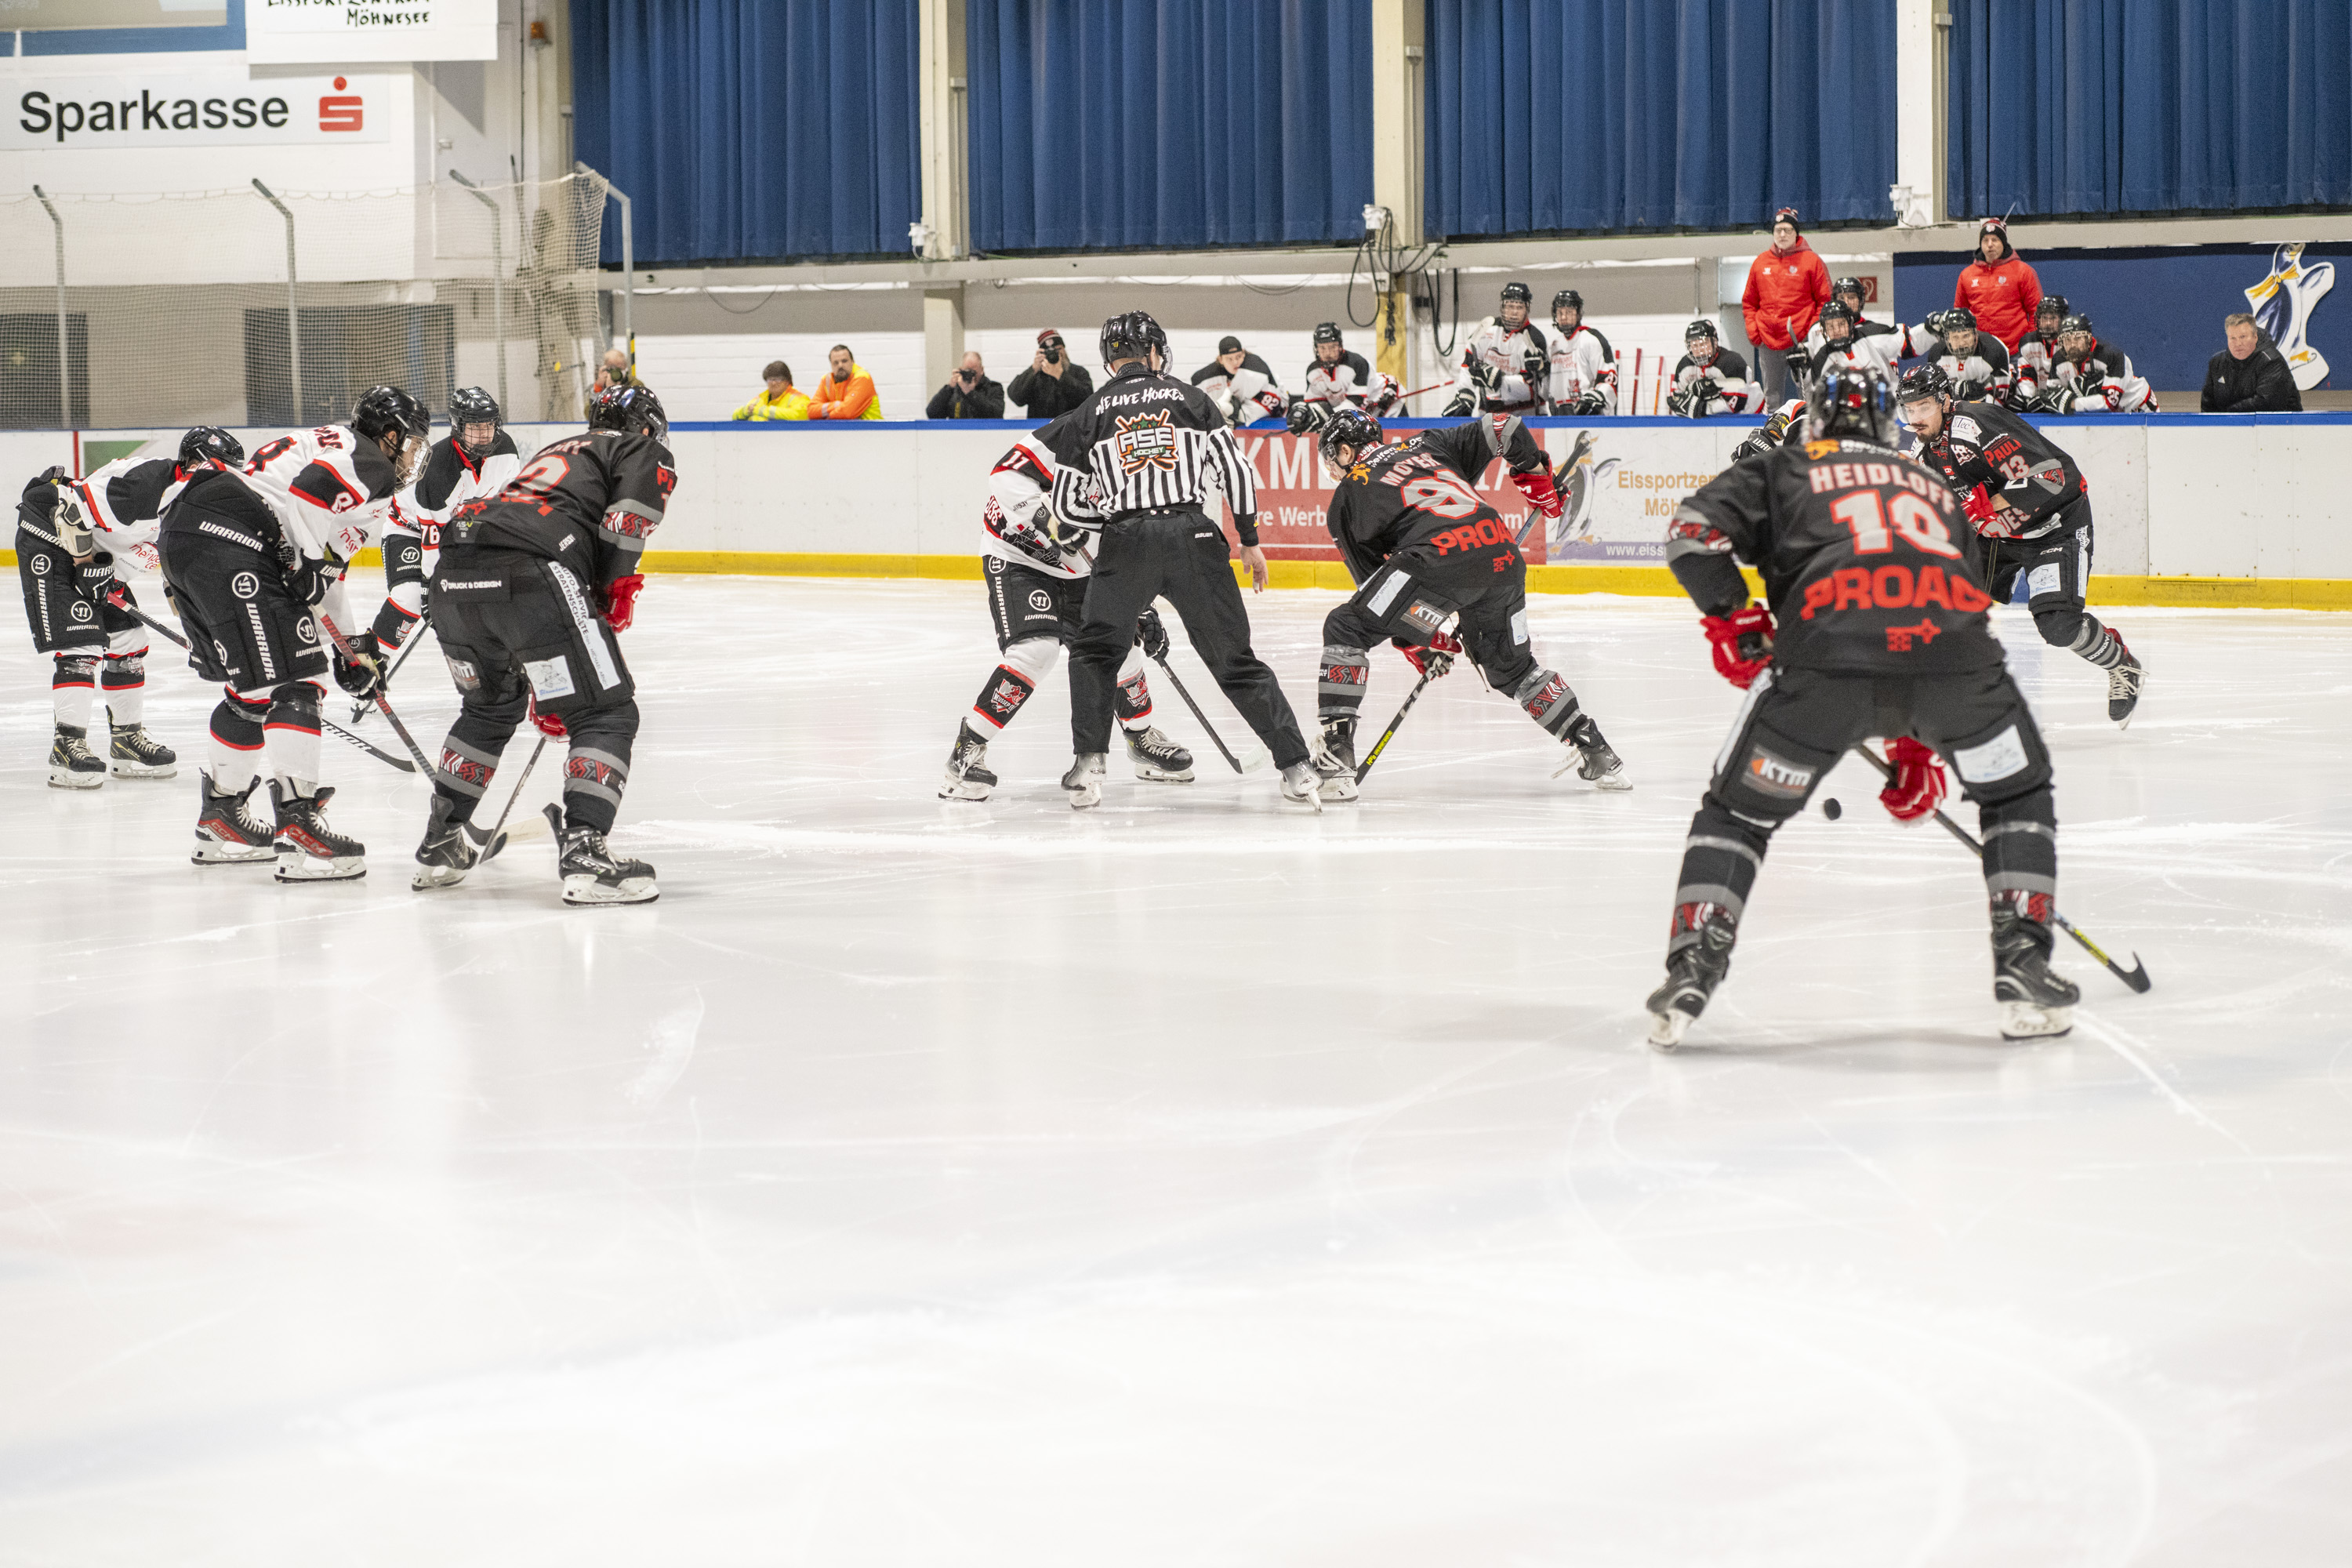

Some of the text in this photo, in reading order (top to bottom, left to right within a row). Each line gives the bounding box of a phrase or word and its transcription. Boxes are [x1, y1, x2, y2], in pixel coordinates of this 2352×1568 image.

[346, 7, 430, 27] MÖHNESEE
[20, 90, 289, 142] Sparkasse
[1095, 395, 1112, 416] WE
[1112, 392, 1140, 408] LIVE
[1119, 426, 1174, 453] ASE
[1134, 446, 1164, 457] HOCKEY
[1379, 452, 1443, 487] MOYER
[1998, 455, 2031, 481] 13
[1808, 463, 1956, 516] HEIDLOFF
[198, 520, 264, 553] WARRIOR
[421, 524, 441, 545] 76
[2040, 546, 2063, 555] CCM
[448, 581, 467, 590] DRUCK
[474, 579, 503, 589] DESIGN
[37, 578, 53, 643] WARRIOR
[994, 576, 1011, 641] WARRIOR
[1024, 614, 1058, 622] WARRIOR
[1414, 606, 1444, 626] KTM
[245, 603, 277, 681] WARRIOR
[1759, 758, 1812, 787] KTM
[211, 821, 235, 841] CCM
[289, 826, 328, 855] CCM
[570, 855, 608, 874] CCM
